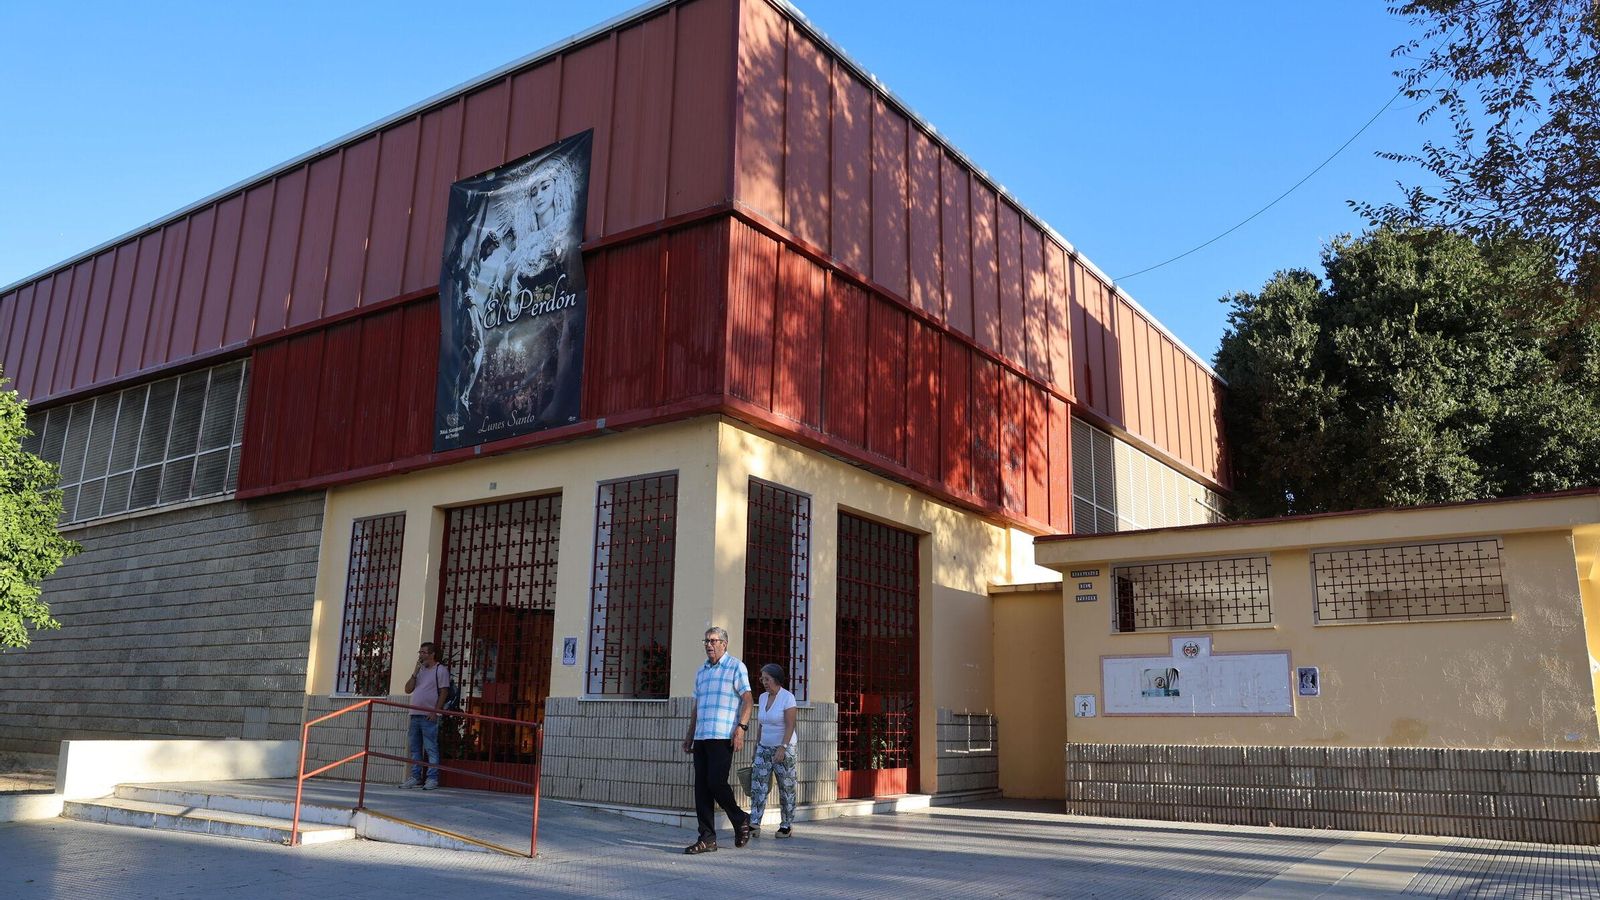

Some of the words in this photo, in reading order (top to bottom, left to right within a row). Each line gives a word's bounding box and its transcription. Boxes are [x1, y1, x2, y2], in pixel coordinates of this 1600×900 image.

[483, 290, 511, 329] El
[506, 273, 577, 322] Perdón
[478, 415, 505, 434] Lunes
[507, 409, 535, 427] Santo
